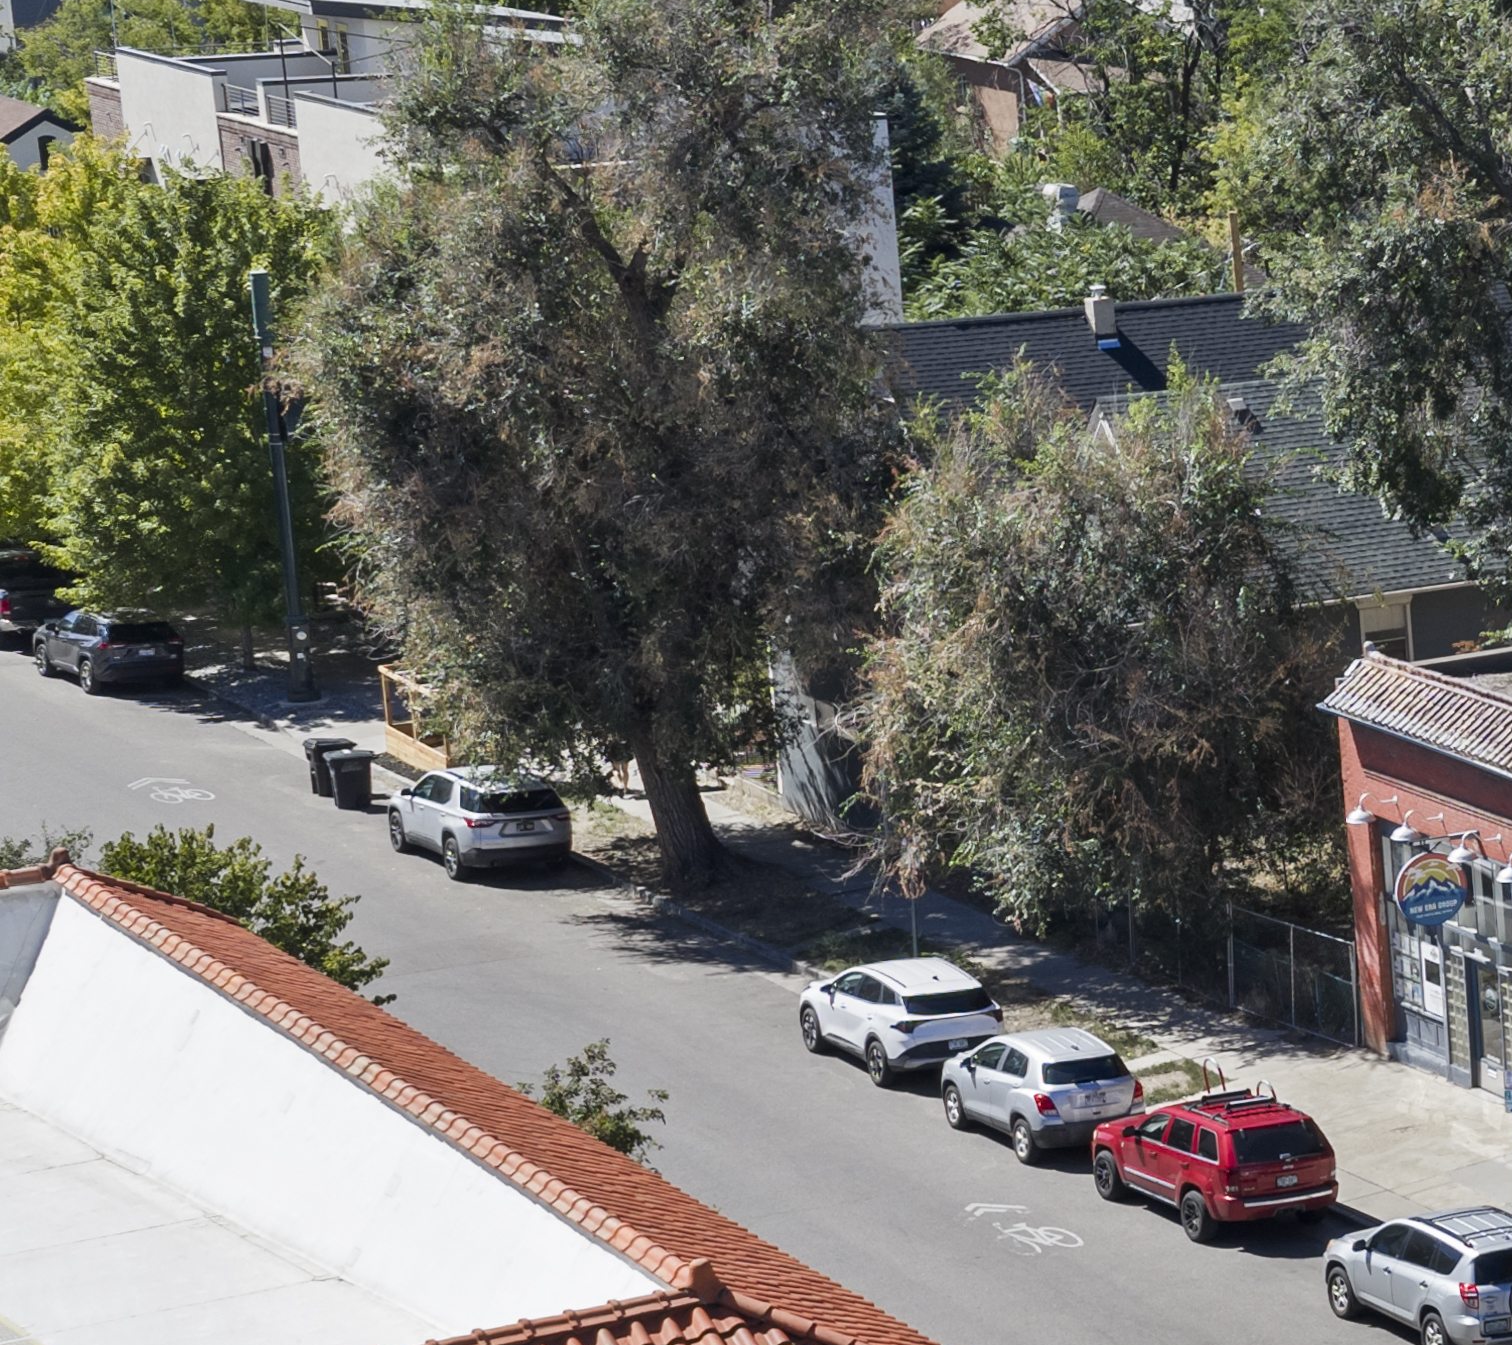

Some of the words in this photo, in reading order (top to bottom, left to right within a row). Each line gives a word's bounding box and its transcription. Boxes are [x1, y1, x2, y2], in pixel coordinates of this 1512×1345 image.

[1410, 904, 1423, 914] NEW
[1425, 901, 1436, 911] ERA
[1438, 898, 1458, 909] GROUP
